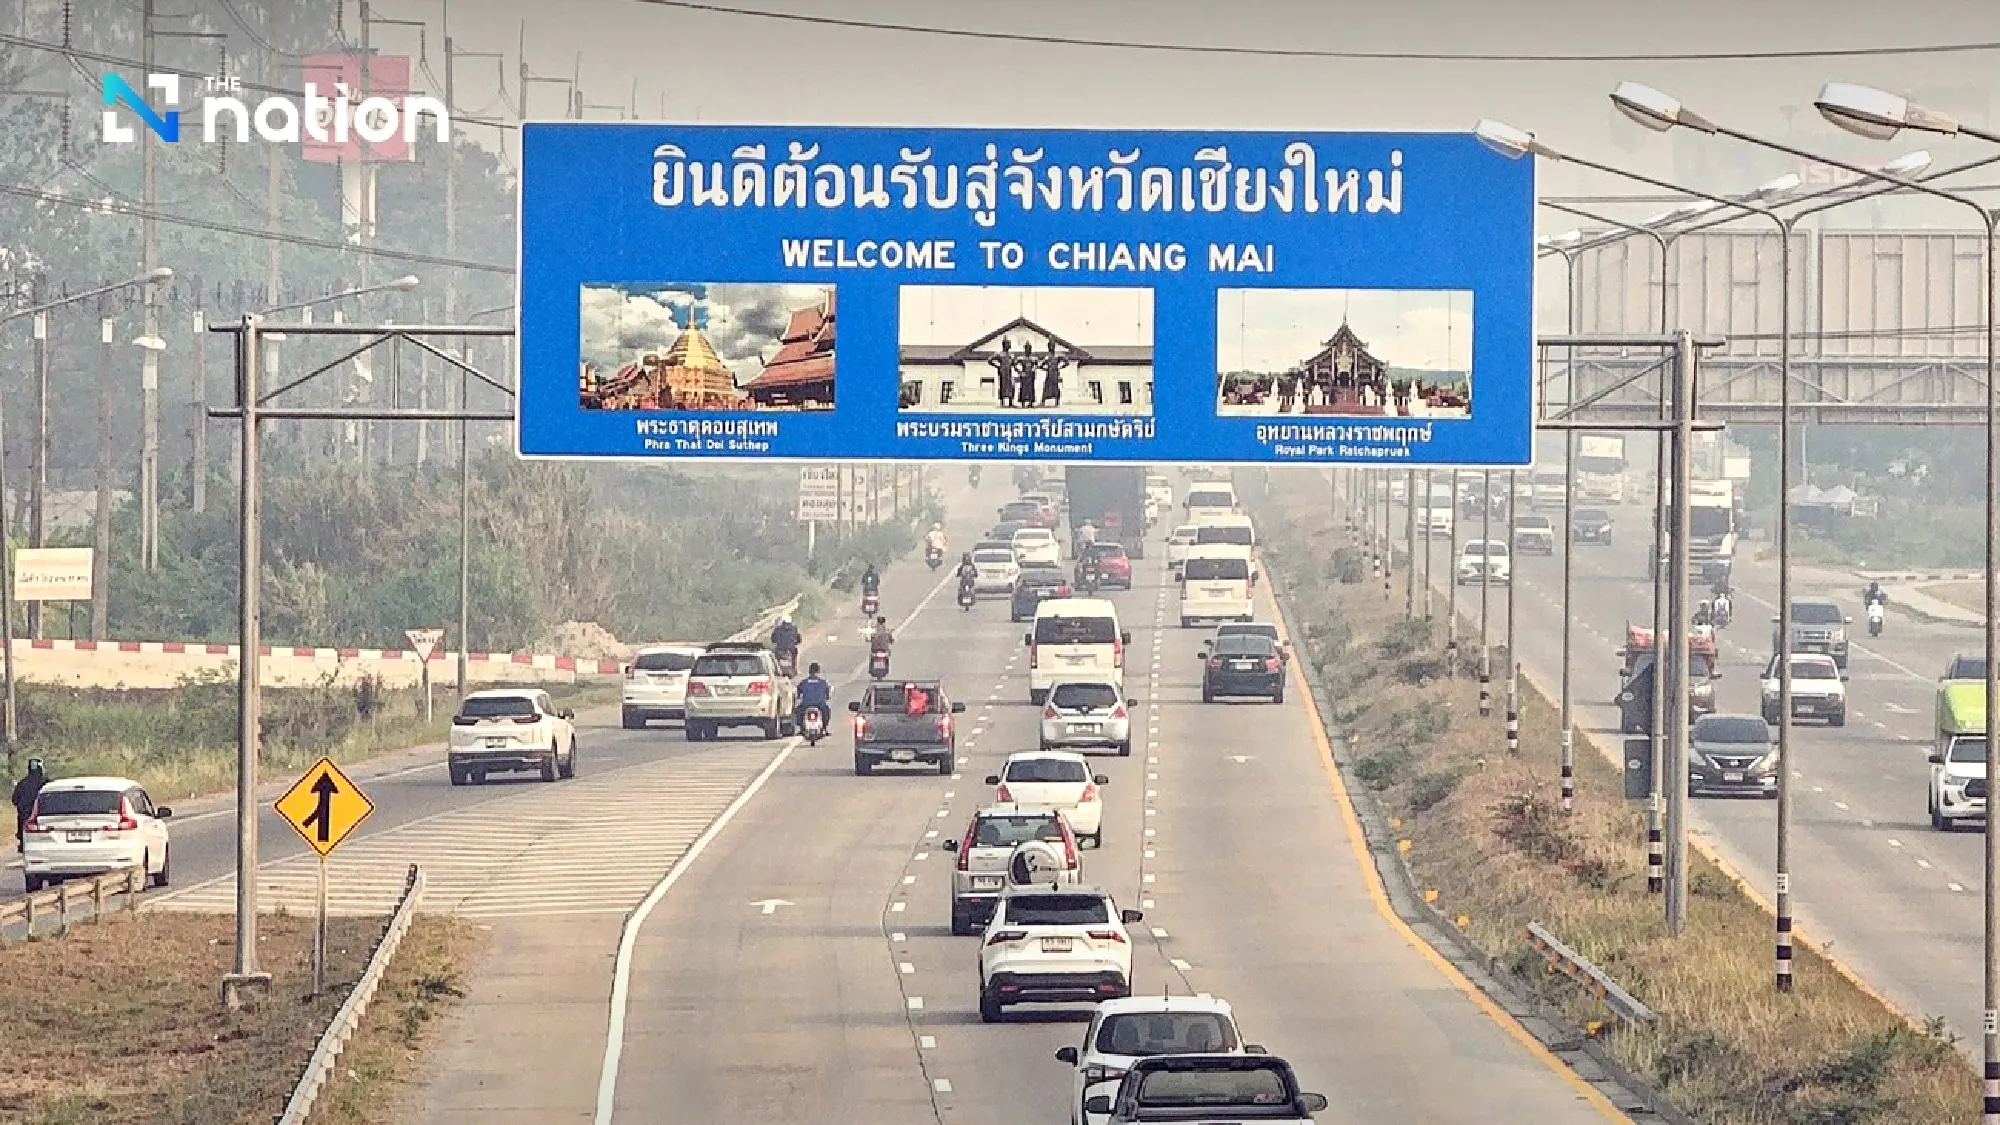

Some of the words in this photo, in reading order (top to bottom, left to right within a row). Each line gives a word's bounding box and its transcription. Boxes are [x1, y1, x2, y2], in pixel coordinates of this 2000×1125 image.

[652, 141, 1403, 228] ยินดีต้อนรับสู่จังหวัดเชียงใหม่
[782, 239, 955, 269] WELCOME
[979, 241, 1024, 270] TO
[1048, 242, 1187, 272] CHIANG
[1208, 244, 1275, 272] MAI
[644, 438, 671, 450] Phra
[674, 438, 702, 450] That
[705, 438, 724, 450] Doi
[728, 438, 769, 452] Suthep
[961, 441, 995, 453] Three
[997, 441, 1030, 456] Kings
[1033, 441, 1093, 453] Monument
[1274, 444, 1306, 457] Royal
[1308, 444, 1335, 456] Park
